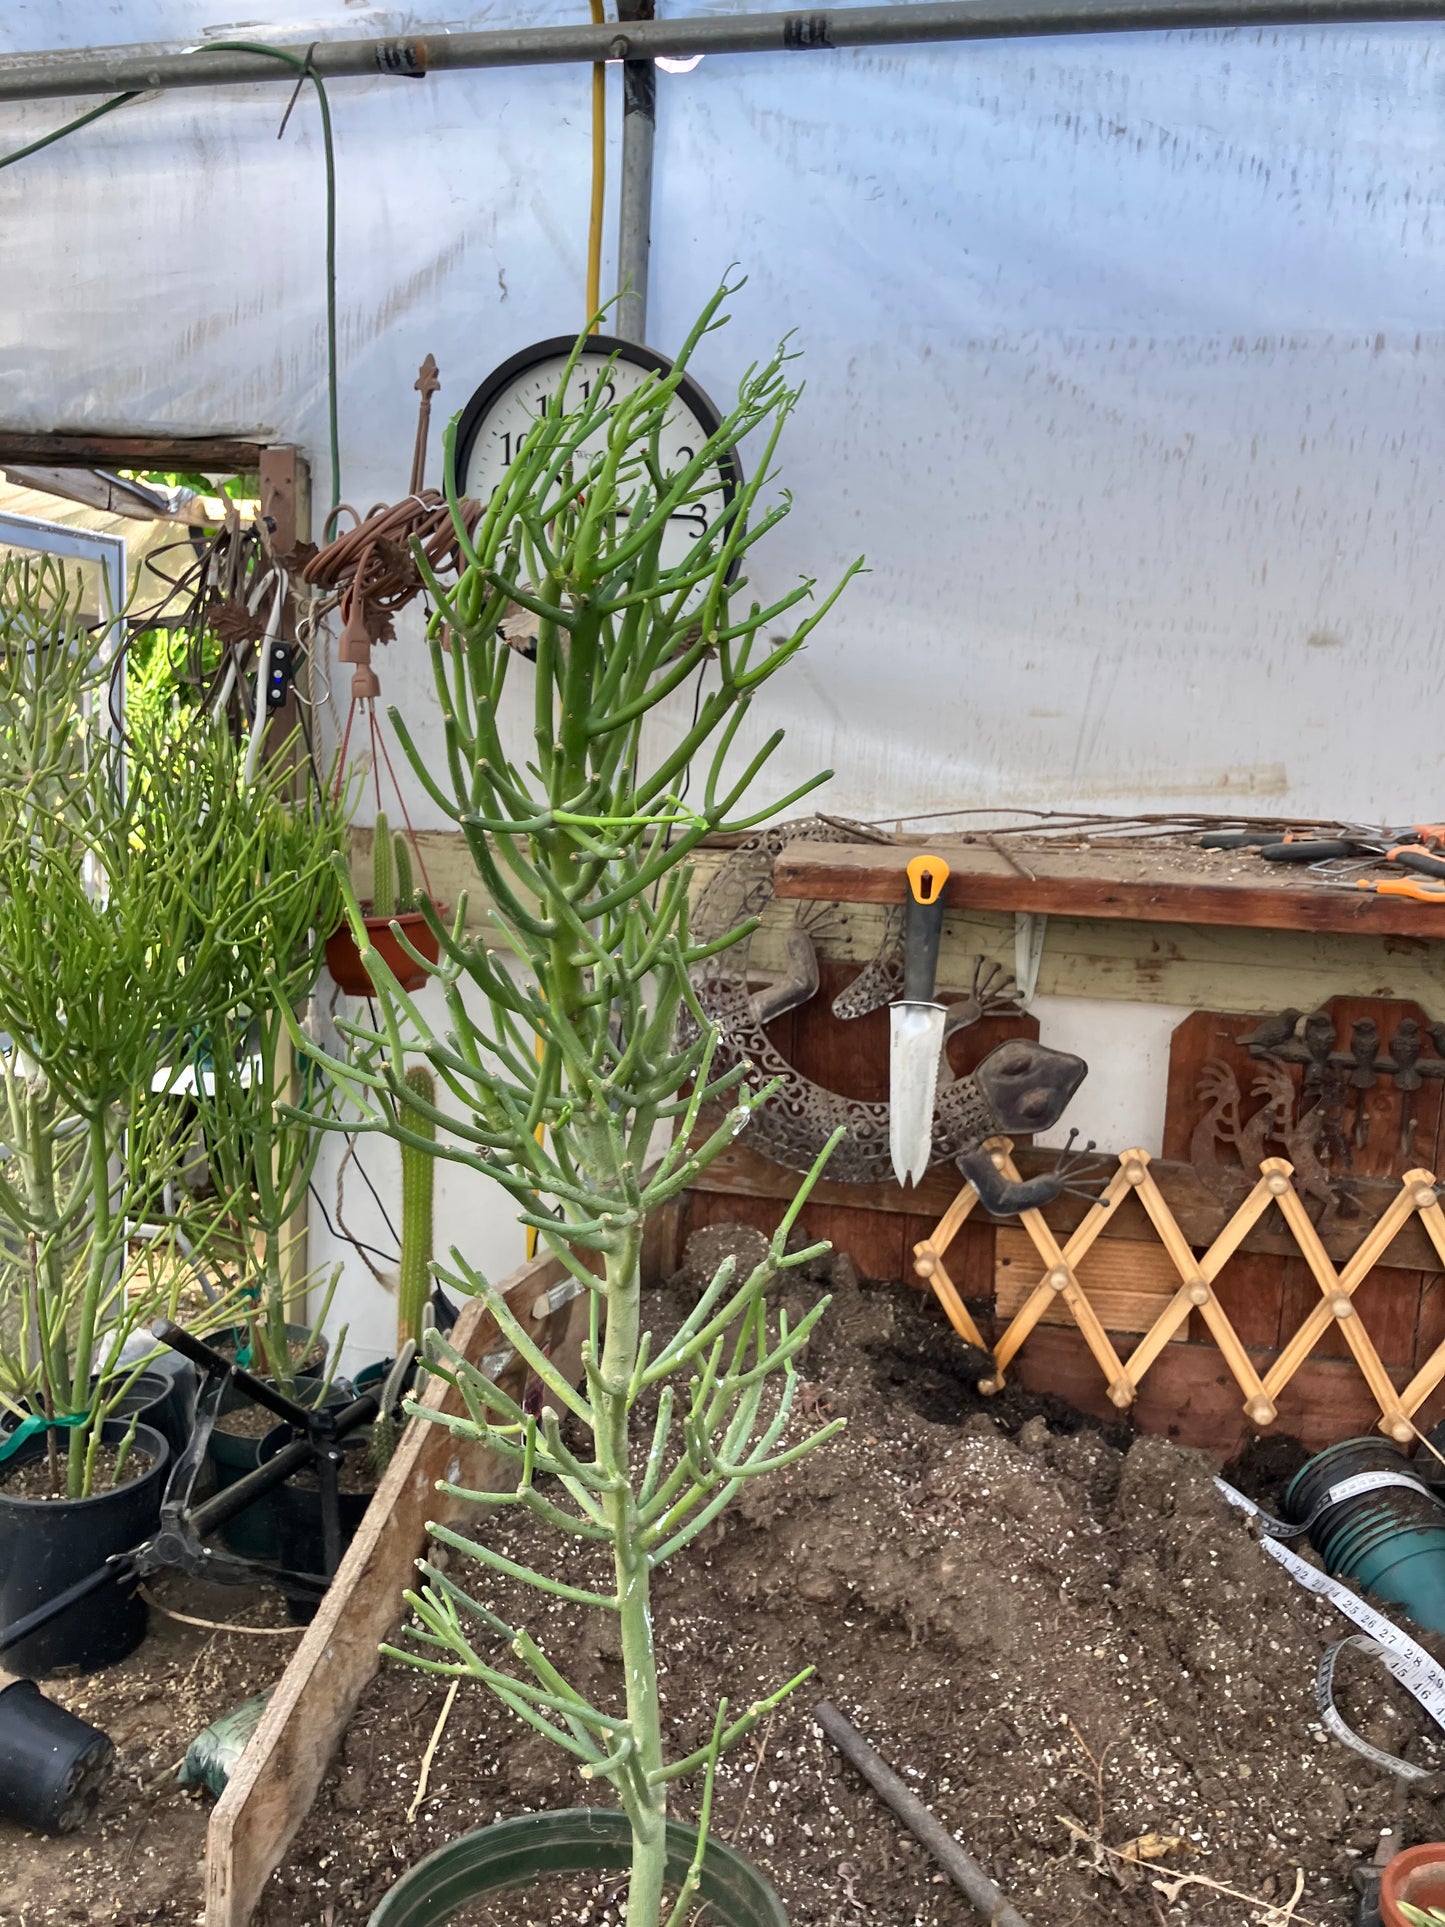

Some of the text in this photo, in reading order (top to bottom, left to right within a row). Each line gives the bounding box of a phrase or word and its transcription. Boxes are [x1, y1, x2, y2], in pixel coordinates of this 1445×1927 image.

[689, 503, 708, 538] 3
[1293, 1566, 1308, 1580] 22
[1342, 1600, 1359, 1615] 25
[1361, 1614, 1376, 1629] 26
[1379, 1628, 1397, 1644] 27
[1403, 1648, 1422, 1667] 28
[1428, 1670, 1444, 1689] 29
